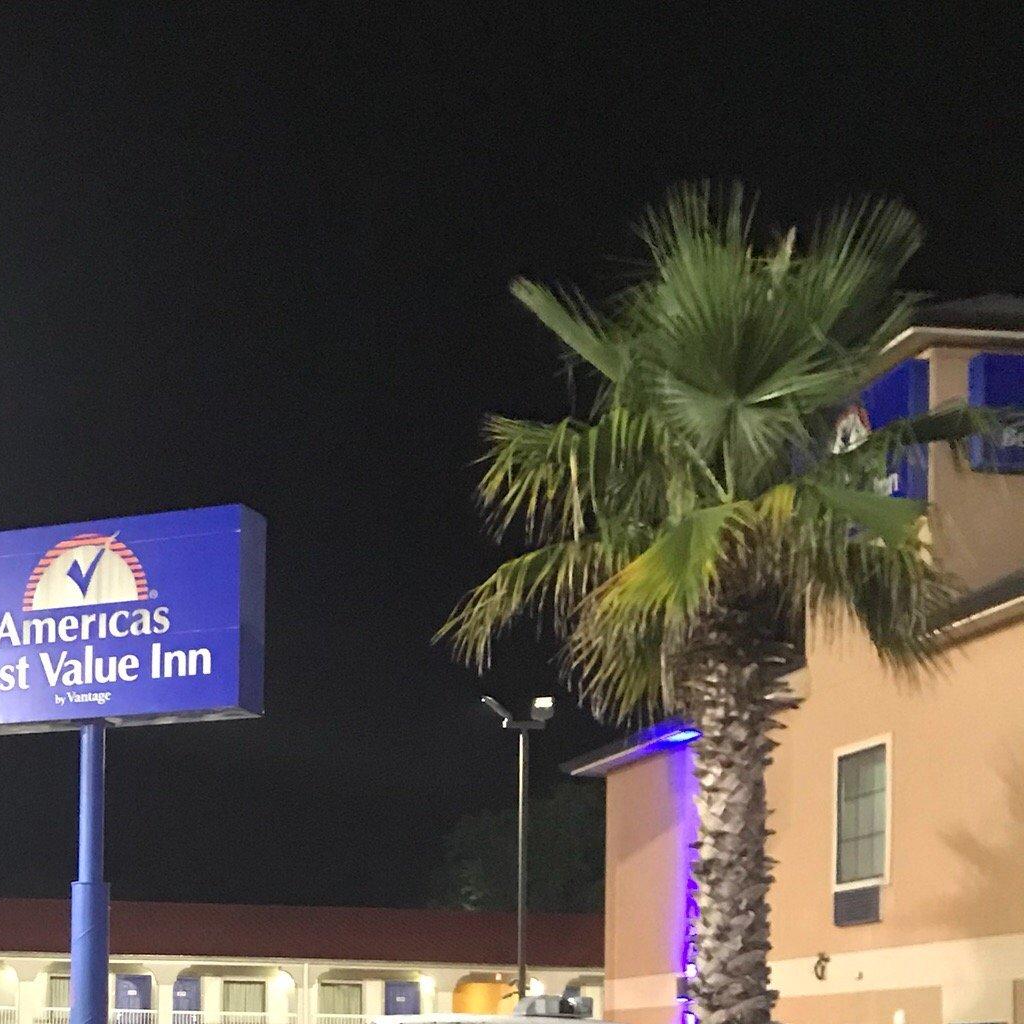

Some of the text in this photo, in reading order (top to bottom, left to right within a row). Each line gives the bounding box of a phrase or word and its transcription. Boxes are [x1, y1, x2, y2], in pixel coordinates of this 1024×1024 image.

[39, 645, 140, 687] Value
[151, 642, 211, 679] Inn
[55, 691, 112, 706] by Vantage
